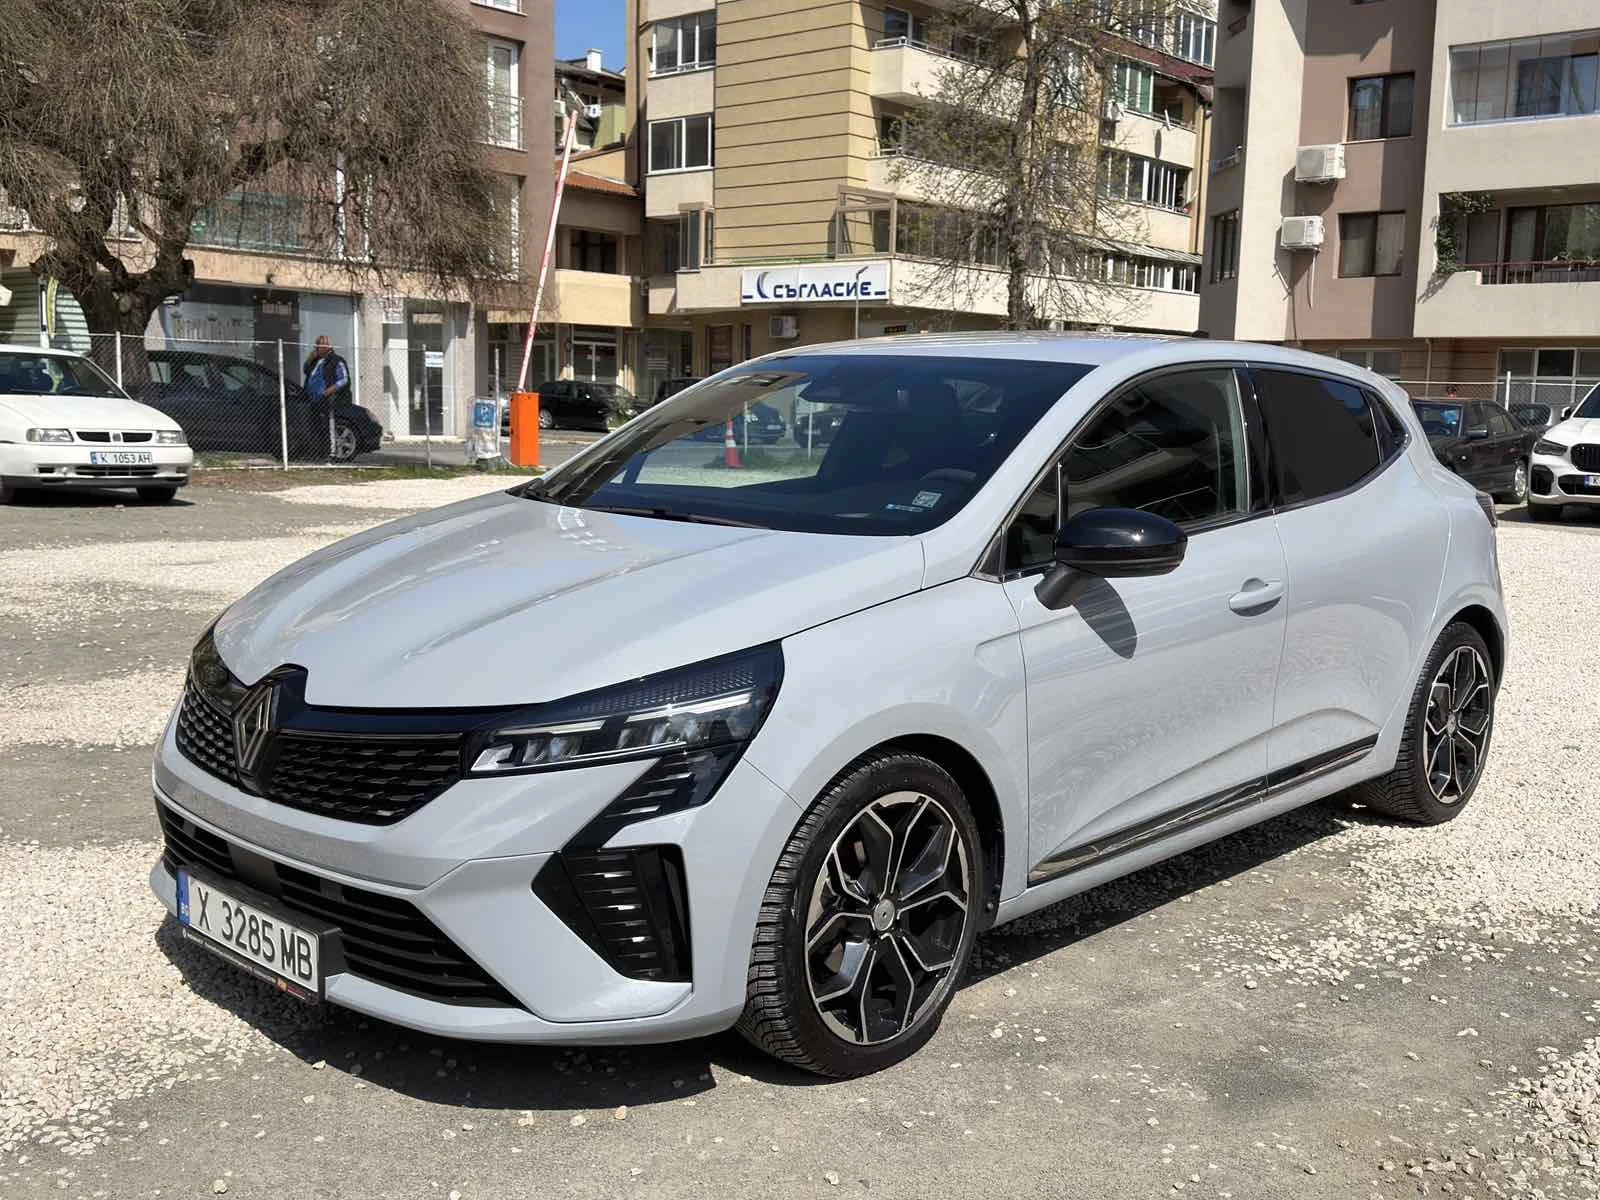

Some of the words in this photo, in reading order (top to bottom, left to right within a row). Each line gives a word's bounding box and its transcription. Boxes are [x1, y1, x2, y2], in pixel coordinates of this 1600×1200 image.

[100, 453, 108, 463] K
[114, 453, 136, 464] 1053
[198, 886, 211, 931] X
[221, 900, 276, 964] 3285
[280, 927, 313, 981] MB
